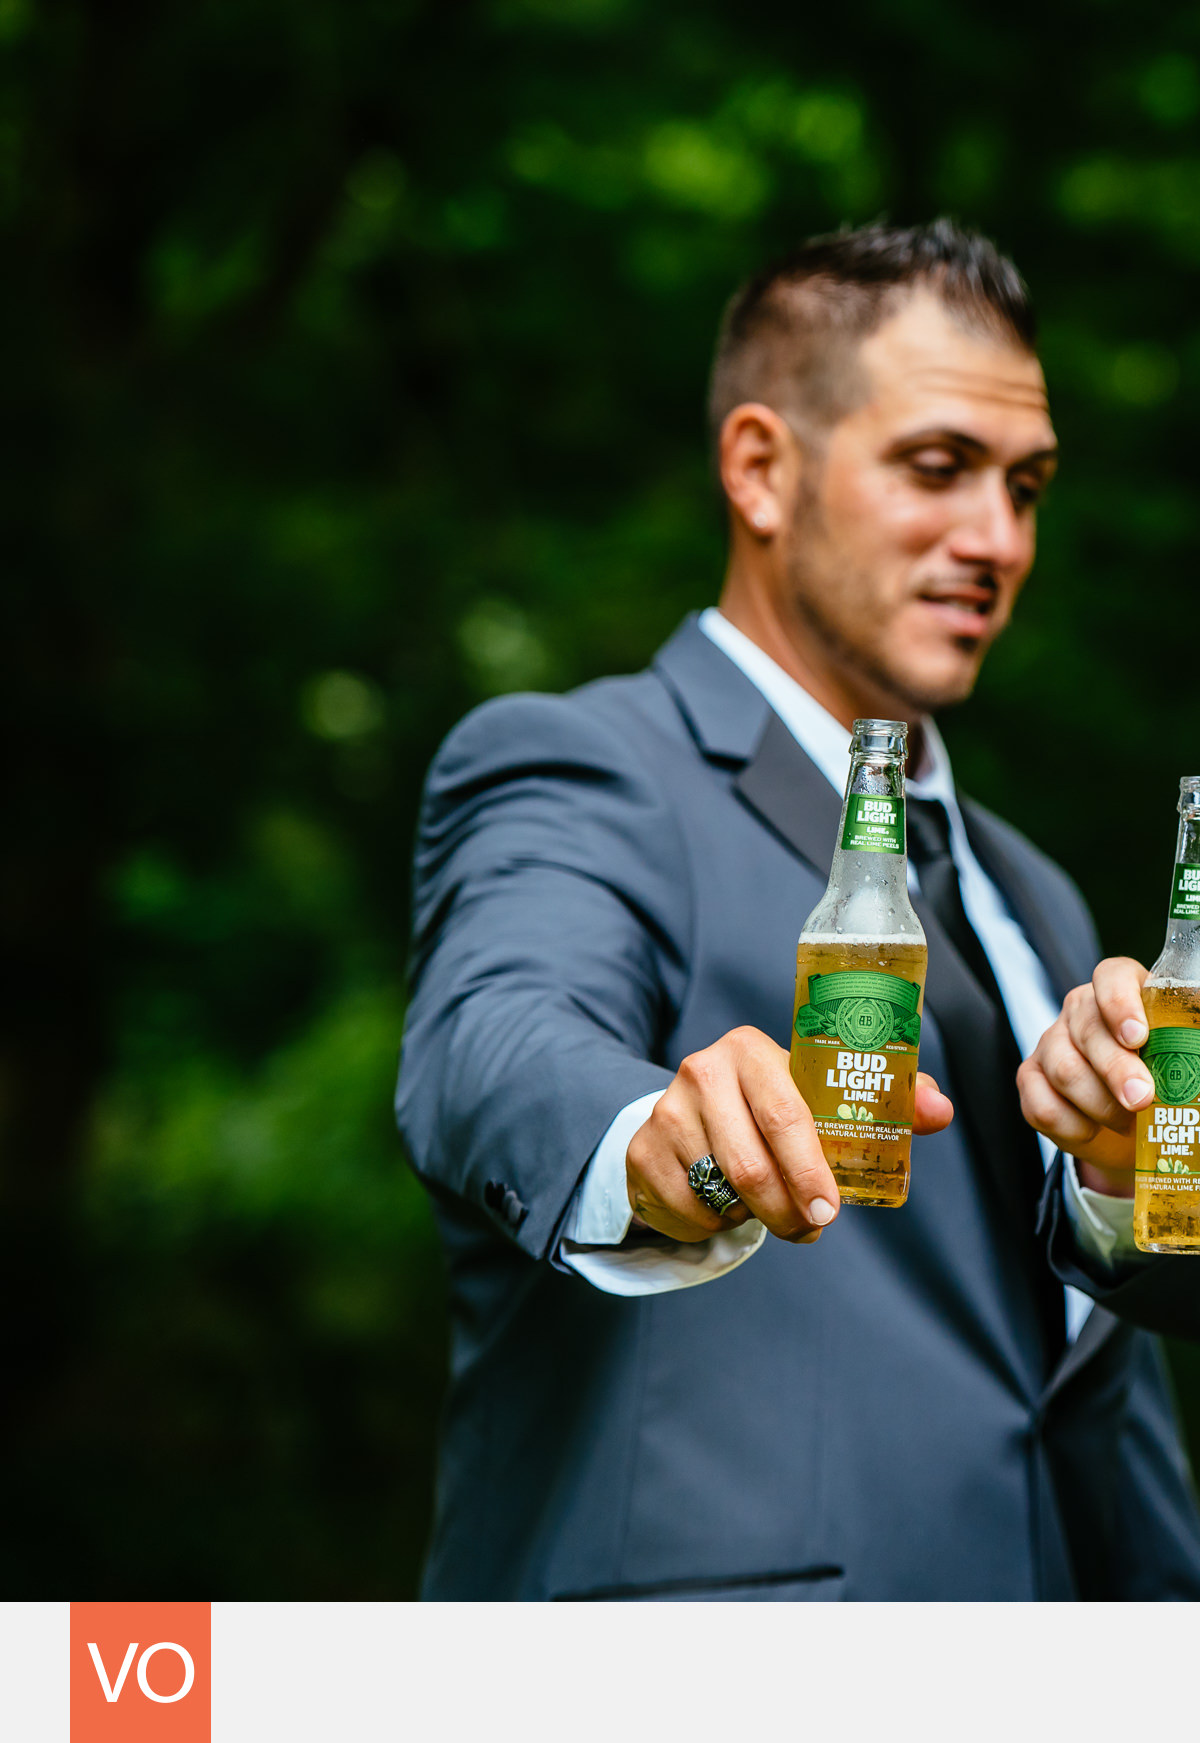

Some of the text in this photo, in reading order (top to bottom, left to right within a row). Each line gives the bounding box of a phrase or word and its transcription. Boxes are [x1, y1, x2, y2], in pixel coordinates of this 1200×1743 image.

[864, 801, 892, 813] BUD
[857, 810, 896, 824] LIGHT
[837, 1051, 887, 1073] BUD
[826, 1069, 895, 1092] LIGHT
[1154, 1107, 1200, 1126] BUD
[824, 1122, 854, 1131] BREWED
[855, 1124, 874, 1132] WITH
[875, 1126, 891, 1134] REAL
[892, 1127, 903, 1135] LIME
[825, 1129, 858, 1138] NATURAL
[859, 1132, 876, 1140] LIME
[877, 1133, 899, 1141] FLAVOR
